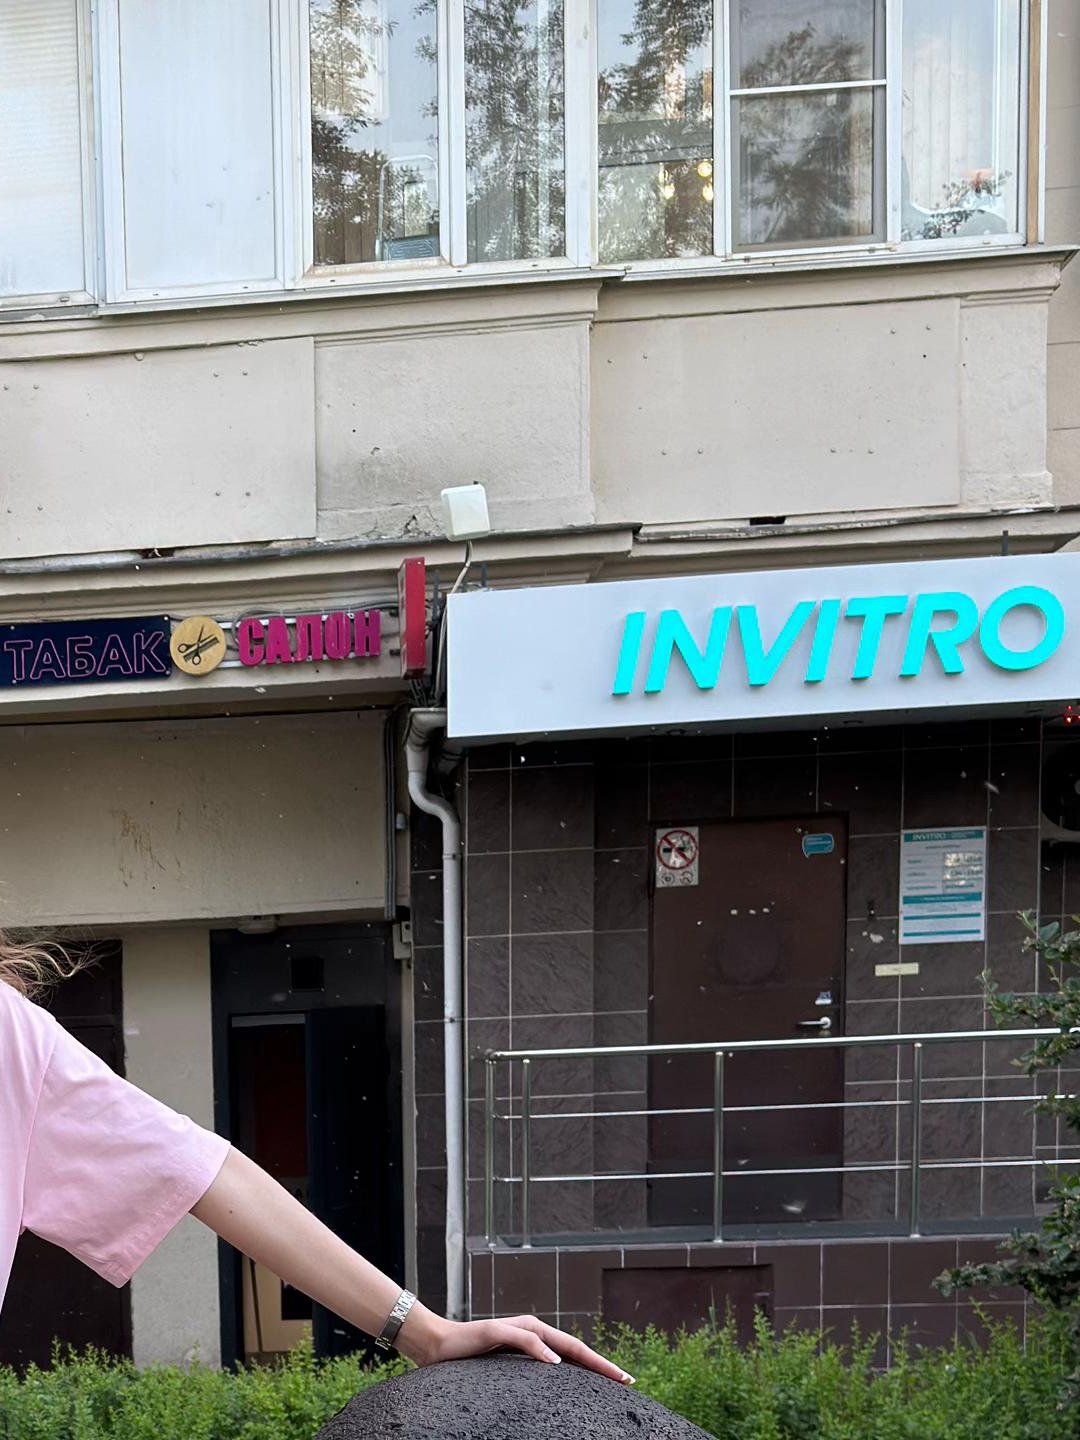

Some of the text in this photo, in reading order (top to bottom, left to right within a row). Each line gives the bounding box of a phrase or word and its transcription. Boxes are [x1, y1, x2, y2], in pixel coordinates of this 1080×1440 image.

[4, 631, 167, 681] ТАБАК
[237, 609, 381, 667] САЛОН
[612, 585, 1065, 695] INVITRO
